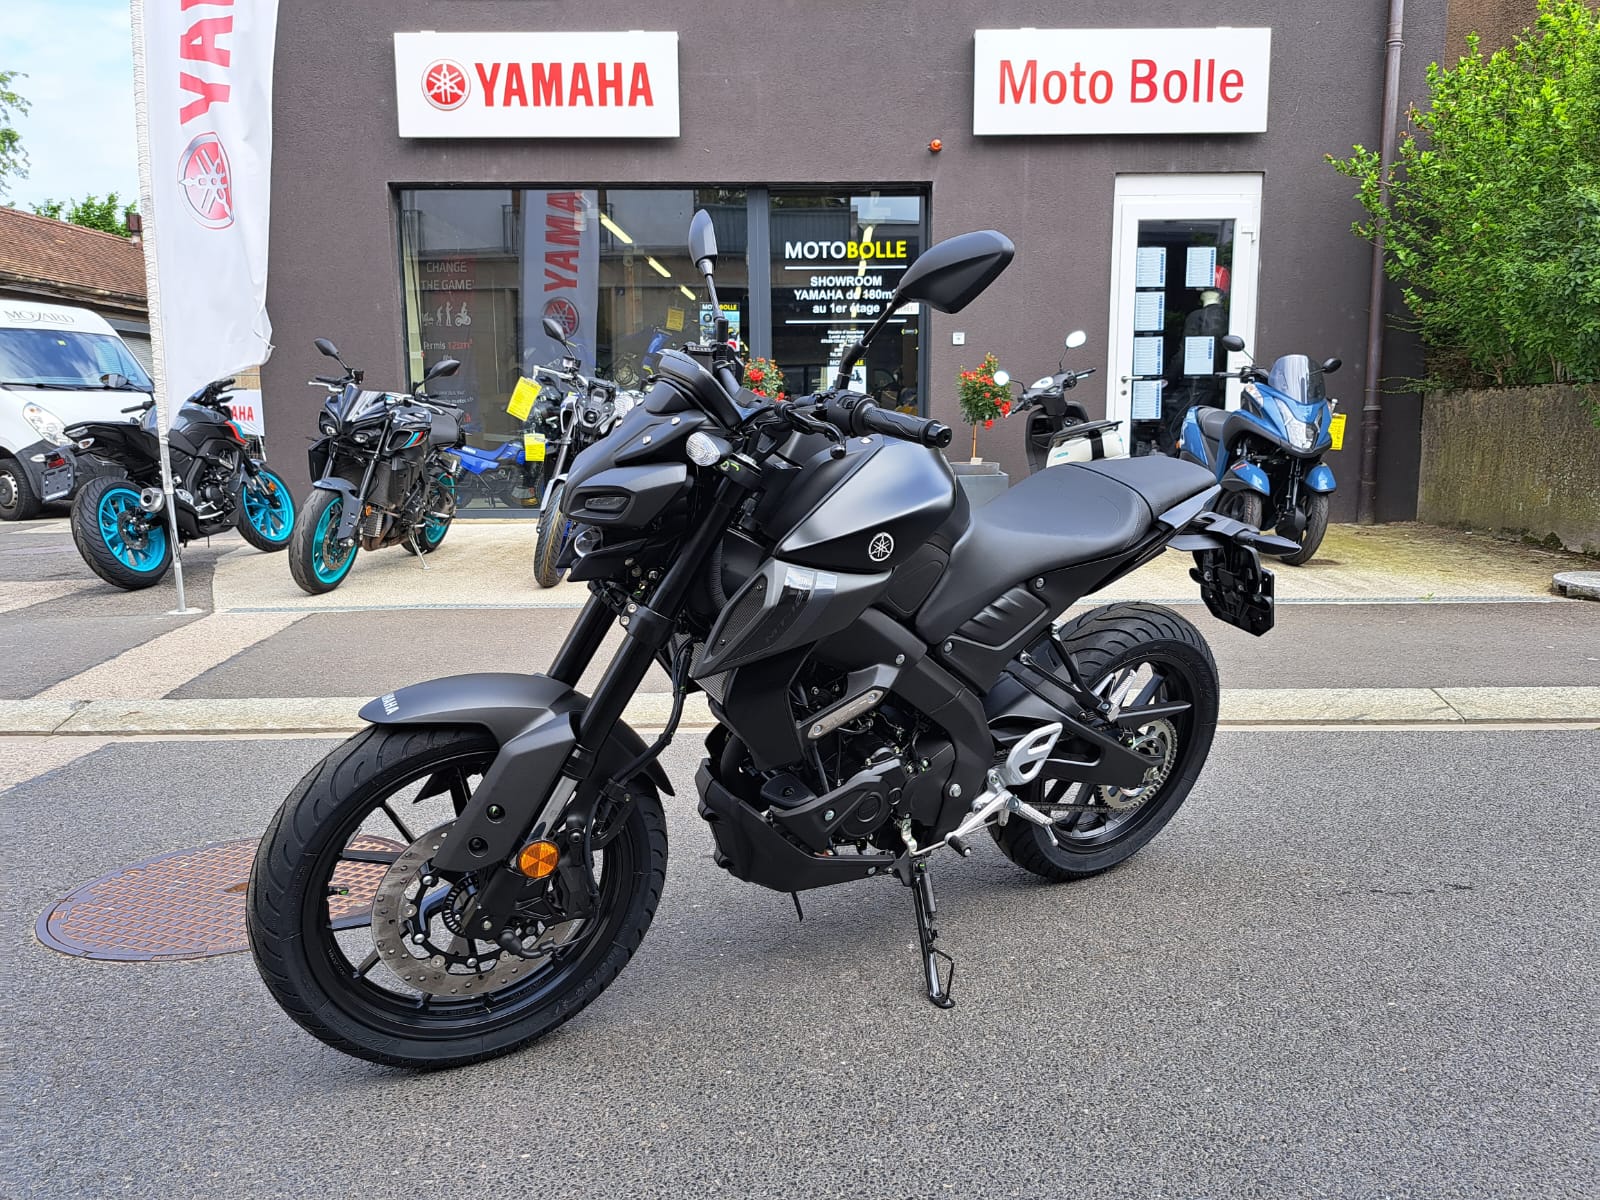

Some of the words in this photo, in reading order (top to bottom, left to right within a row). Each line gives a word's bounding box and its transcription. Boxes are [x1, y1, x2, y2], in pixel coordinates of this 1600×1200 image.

[180, 0, 235, 125] YA
[474, 62, 654, 107] YAMAHA
[999, 59, 1113, 104] Moto
[1130, 58, 1244, 103] Bolle
[784, 240, 907, 259] MOTOBOLLE
[426, 262, 467, 273] CHANGE
[421, 280, 440, 289] THE
[810, 275, 882, 287] SHOWROOM
[793, 289, 844, 300] YAMAHA
[812, 305, 829, 314] au
[829, 303, 847, 314] 1er
[849, 302, 880, 315] étage
